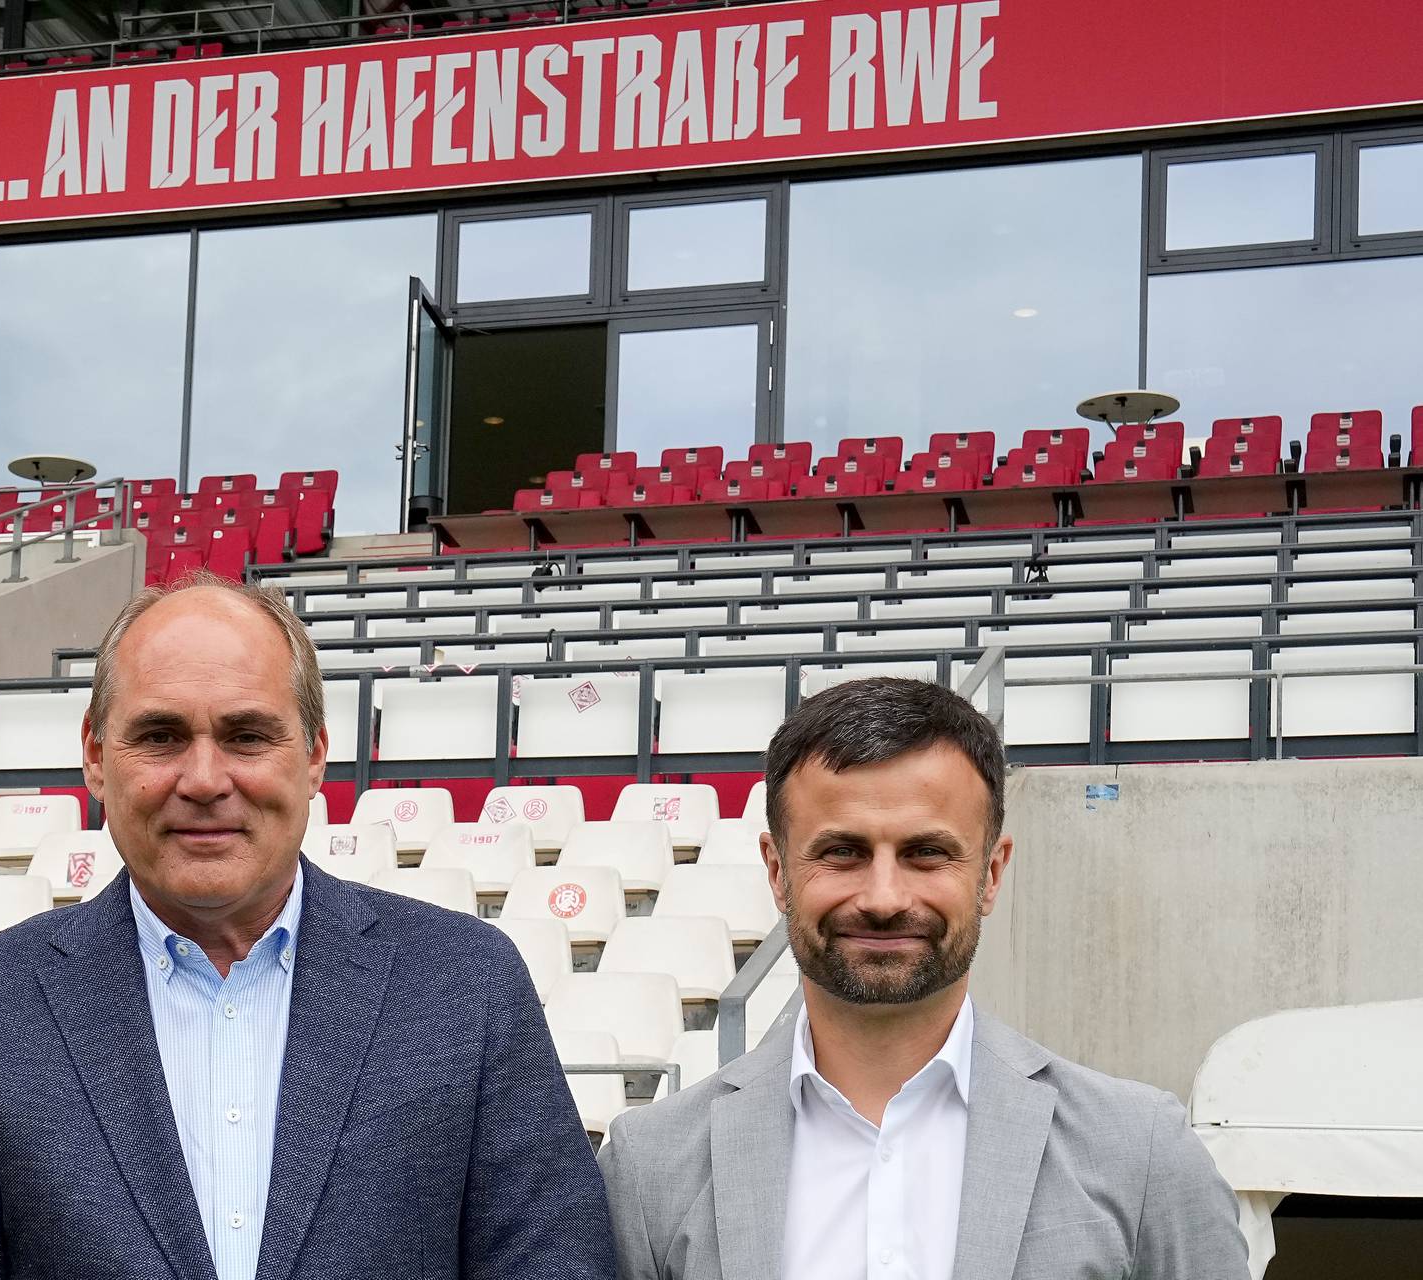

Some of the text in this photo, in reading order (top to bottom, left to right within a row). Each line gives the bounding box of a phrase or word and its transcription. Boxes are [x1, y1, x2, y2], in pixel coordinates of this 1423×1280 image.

[40, 84, 130, 198] AN
[149, 70, 279, 189] DER
[827, 0, 1000, 132] RWE
[24, 806, 48, 814] 1907
[473, 835, 500, 844] 1907
